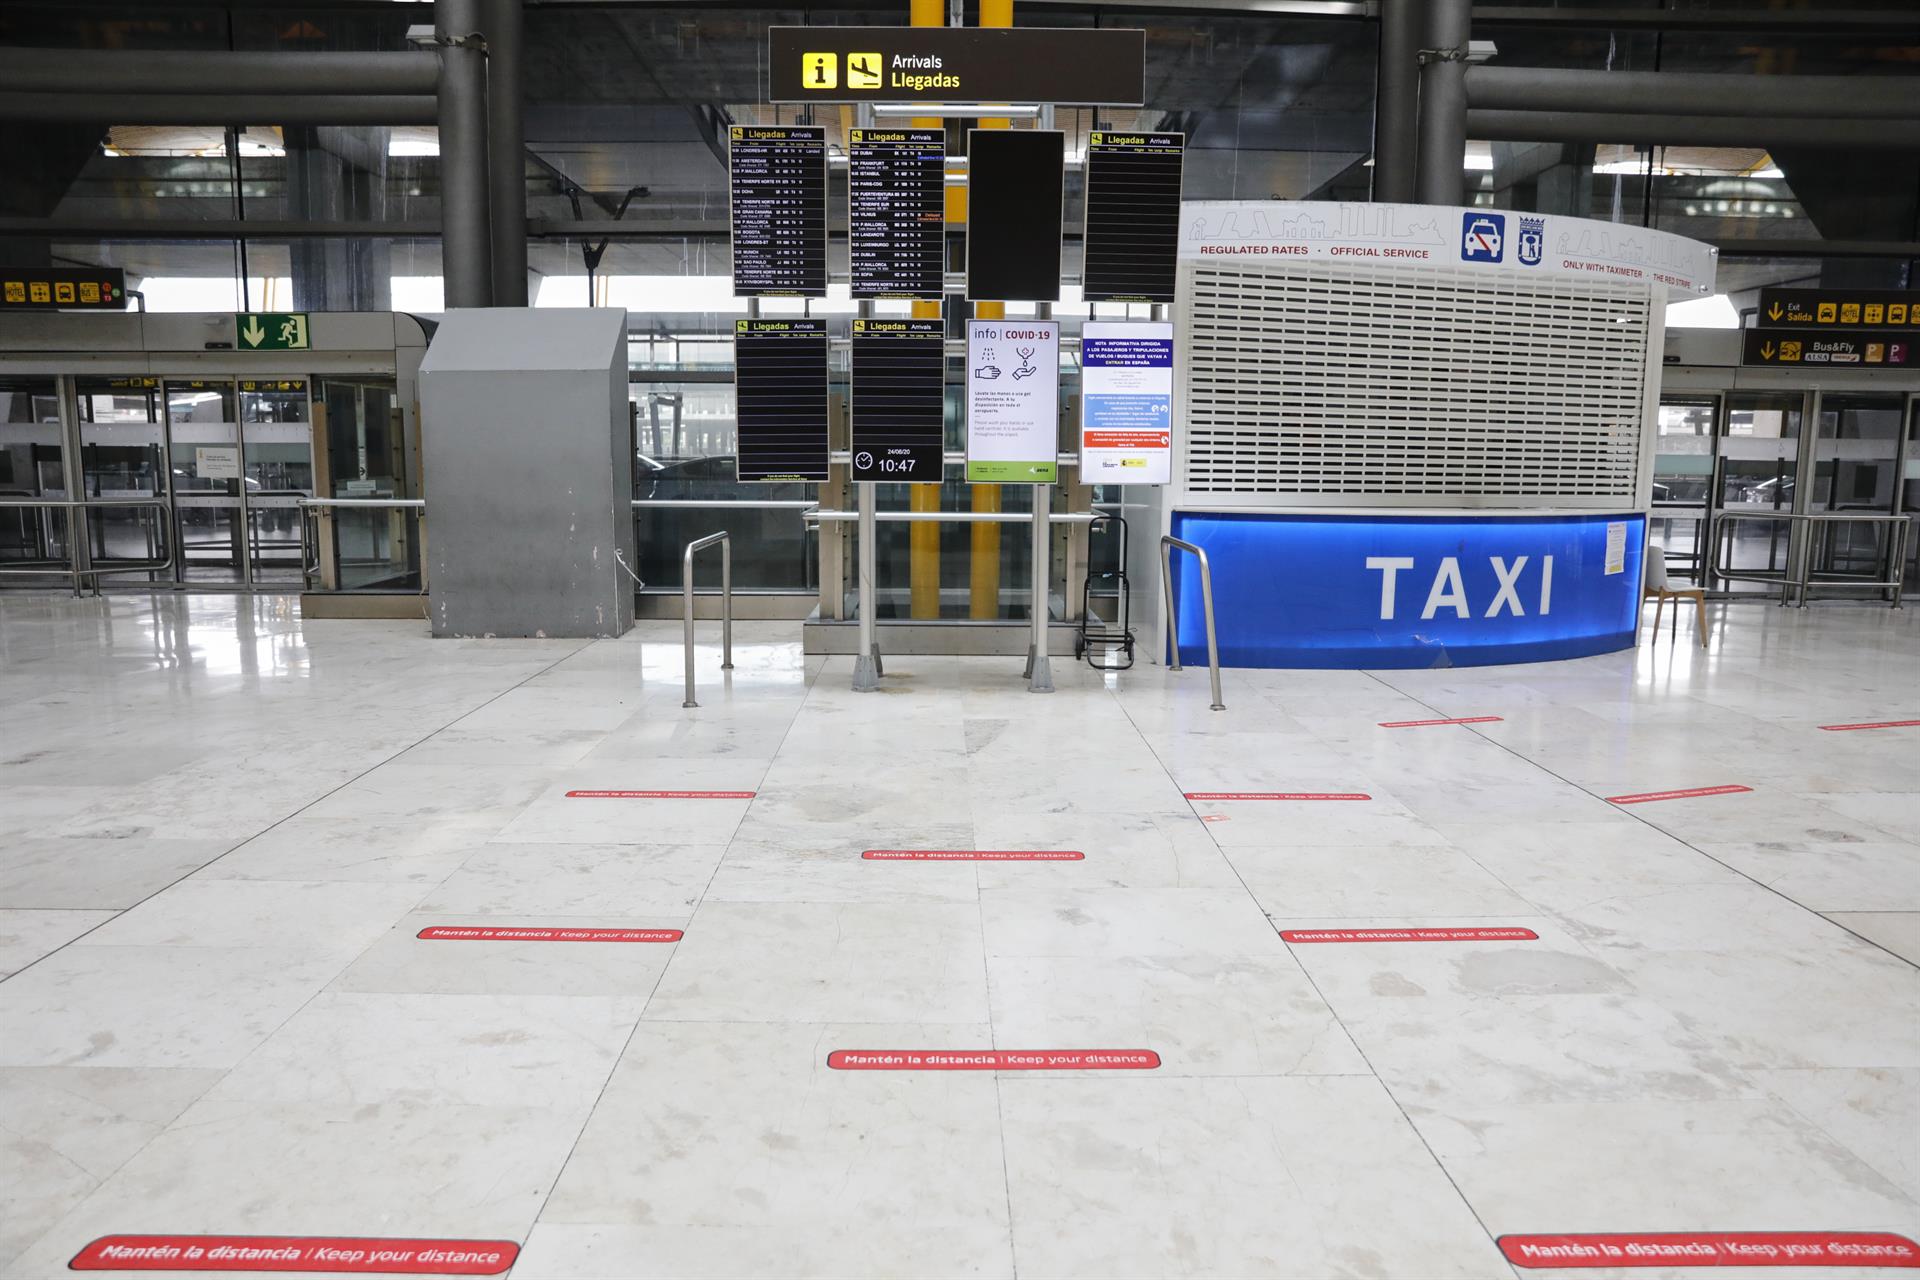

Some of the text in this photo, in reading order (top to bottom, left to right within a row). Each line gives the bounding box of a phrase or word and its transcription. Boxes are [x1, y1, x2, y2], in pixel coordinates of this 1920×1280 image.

[892, 54, 942, 69] Arrivals
[891, 73, 960, 90] Llegadas
[749, 130, 785, 139] Llegadas
[868, 133, 906, 142] Llegadas
[1108, 136, 1144, 145] Llegadas
[1200, 246, 1429, 258] REGULATED RATES OFFICIAL SERVICE
[1563, 260, 1642, 278] ONLY WITH TAXIMETER
[1653, 274, 1691, 288] THE RED STRIPE
[7, 288, 23, 296] HOTEL
[1787, 313, 1812, 322] Salida
[870, 323, 906, 331] Llegadas
[974, 328, 1050, 340] info COVID-19
[1813, 342, 1854, 353] Bus&Fly
[878, 459, 916, 472] 10:47
[1366, 555, 1553, 620] TAXI
[100, 1246, 500, 1263] Mantén la distancia Keep your distance
[1520, 1243, 1910, 1257] Mantén la distancia Keep your distance
